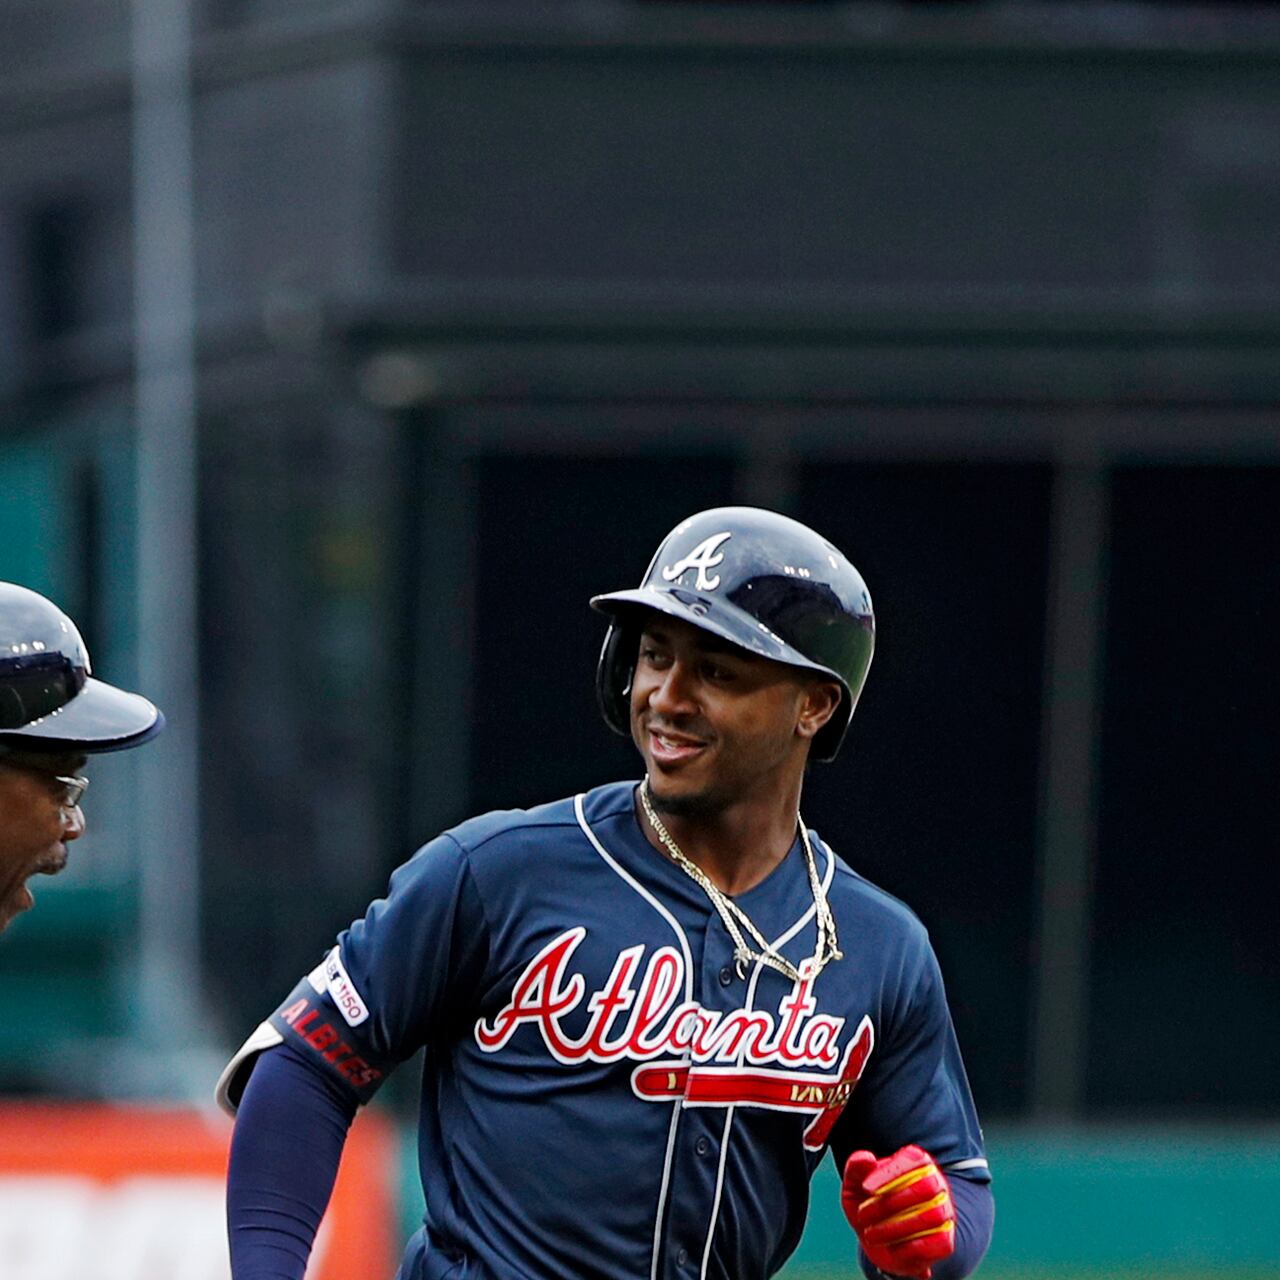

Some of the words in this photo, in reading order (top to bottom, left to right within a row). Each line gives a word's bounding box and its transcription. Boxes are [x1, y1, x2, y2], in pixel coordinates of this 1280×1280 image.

[662, 531, 731, 590] A
[474, 926, 845, 1066] Atlanta
[281, 998, 382, 1087] ALBIES
